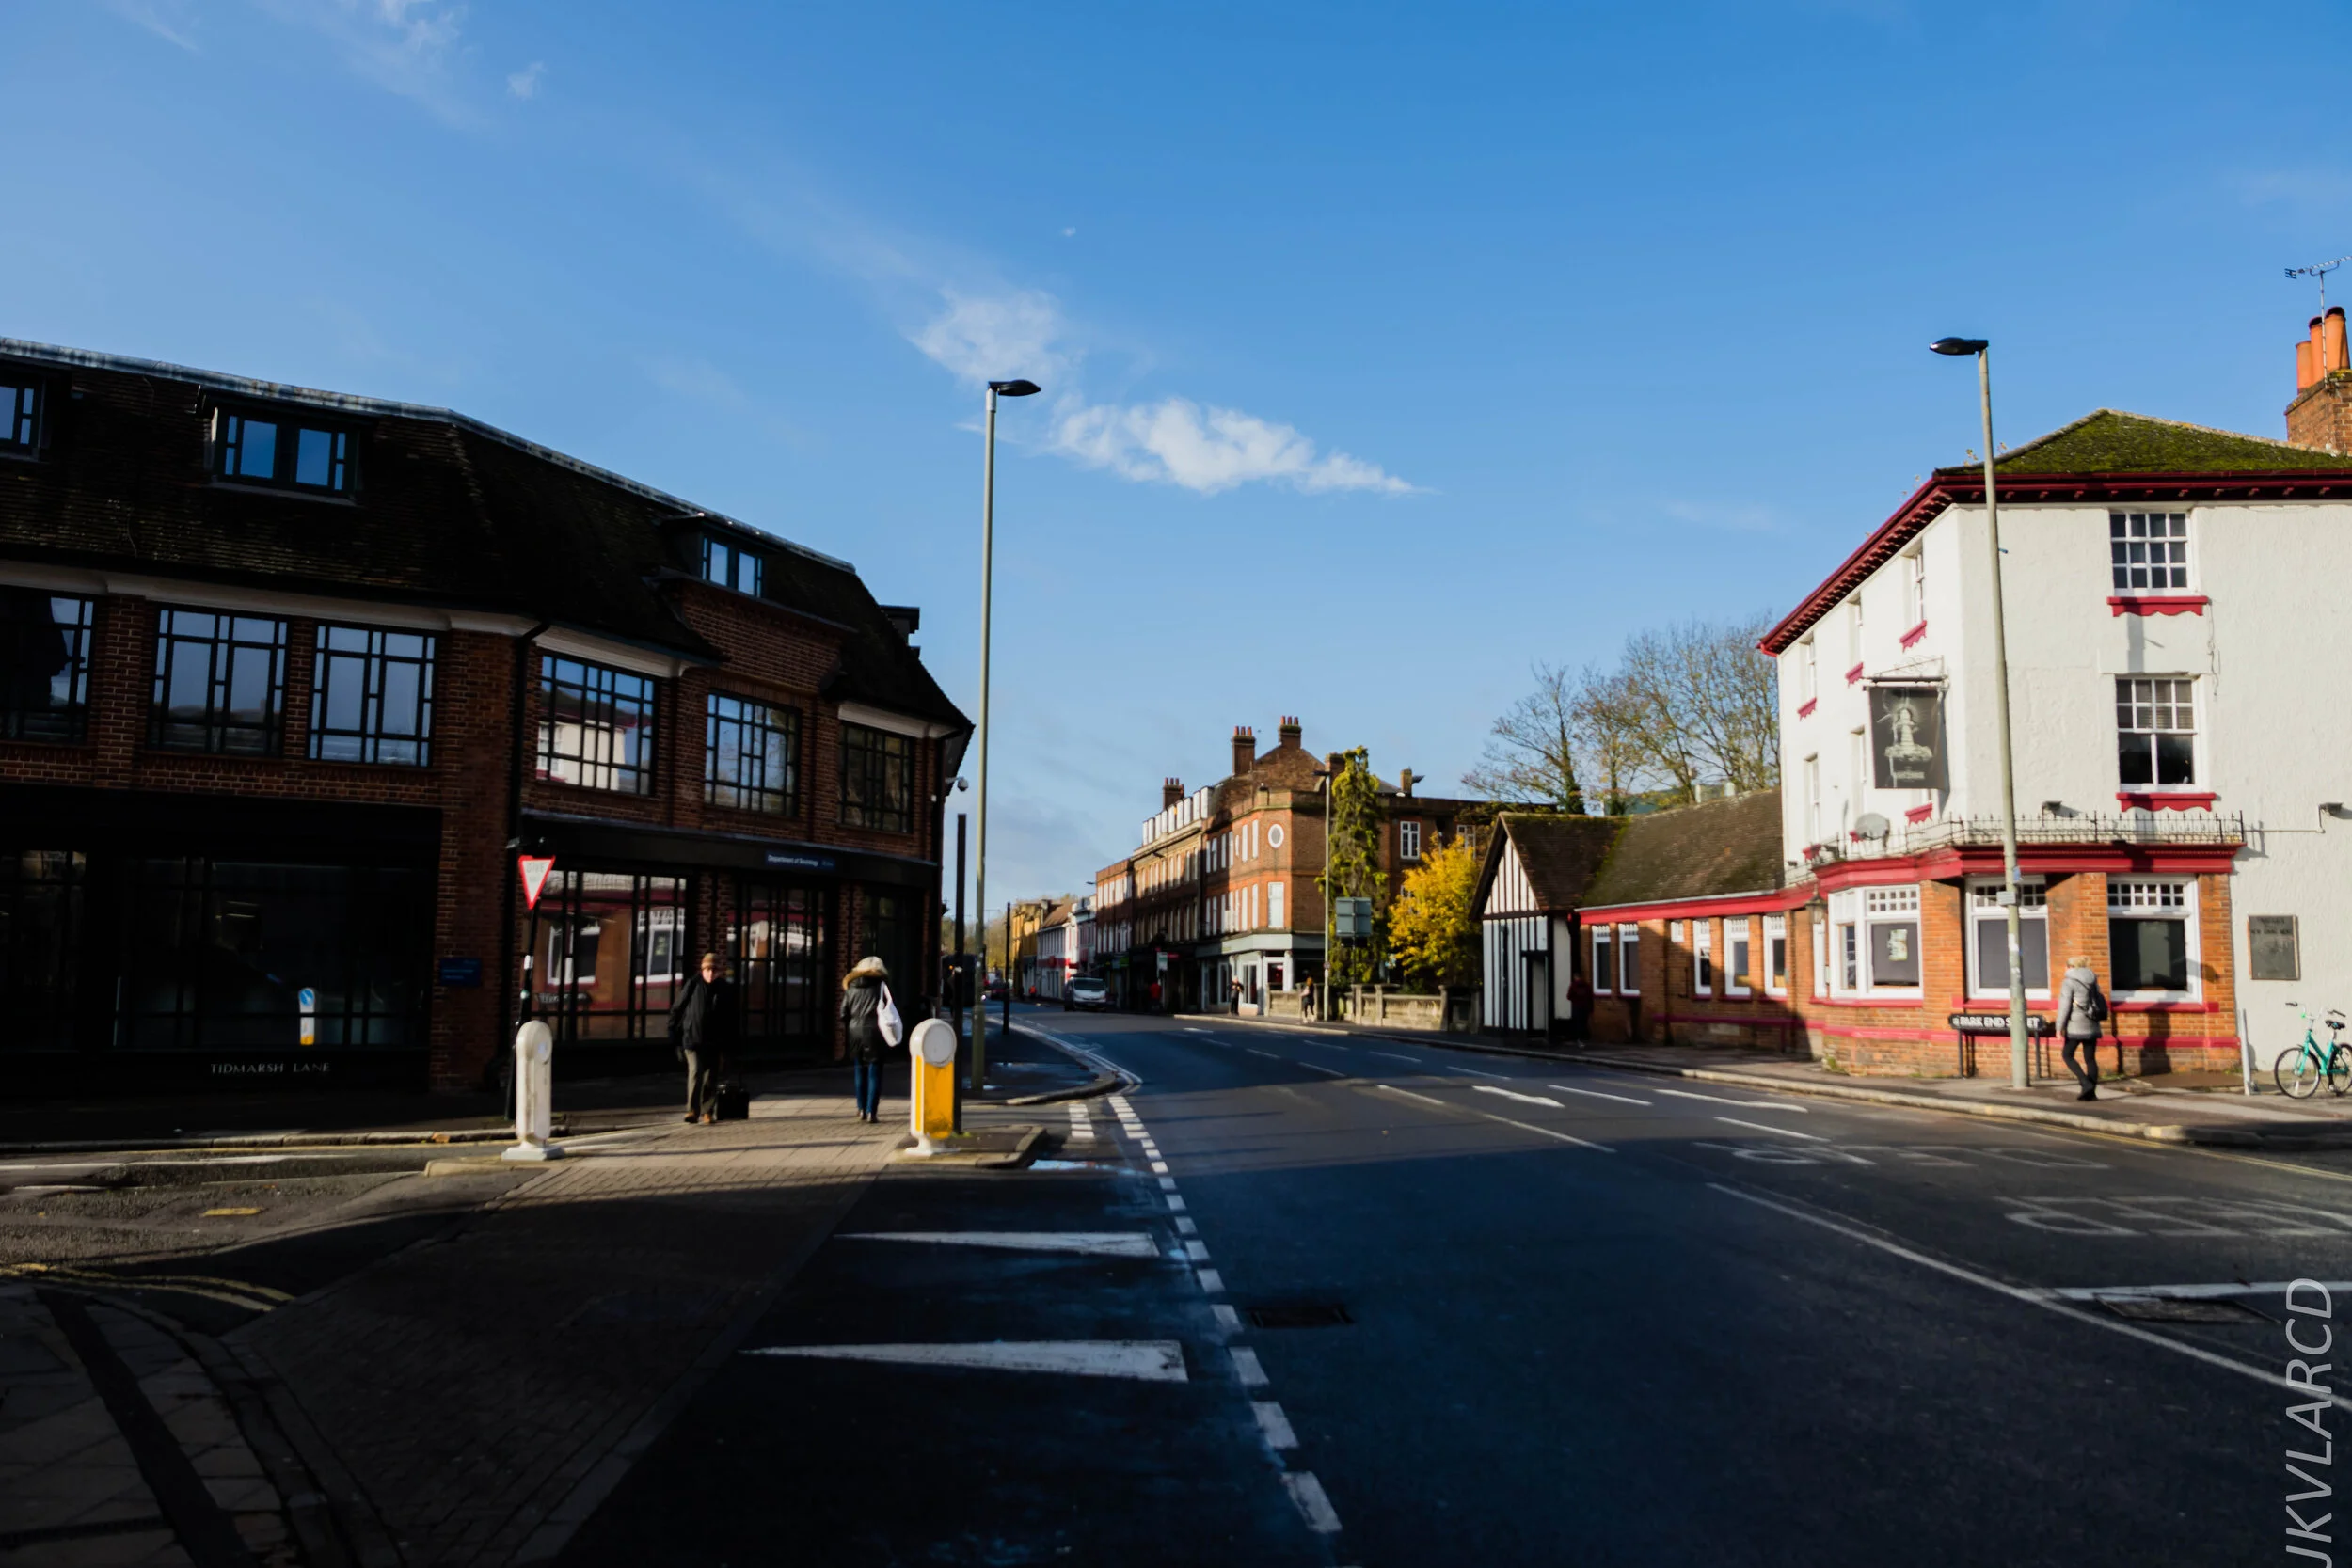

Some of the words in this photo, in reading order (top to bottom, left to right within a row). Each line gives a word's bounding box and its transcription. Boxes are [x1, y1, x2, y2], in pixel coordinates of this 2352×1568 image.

[1960, 1016, 1983, 1027] PARK
[1984, 1017, 2005, 1028] END
[2006, 1017, 2040, 1029] SET
[211, 1062, 284, 1074] TIDMARSH
[293, 1062, 331, 1073] LANE
